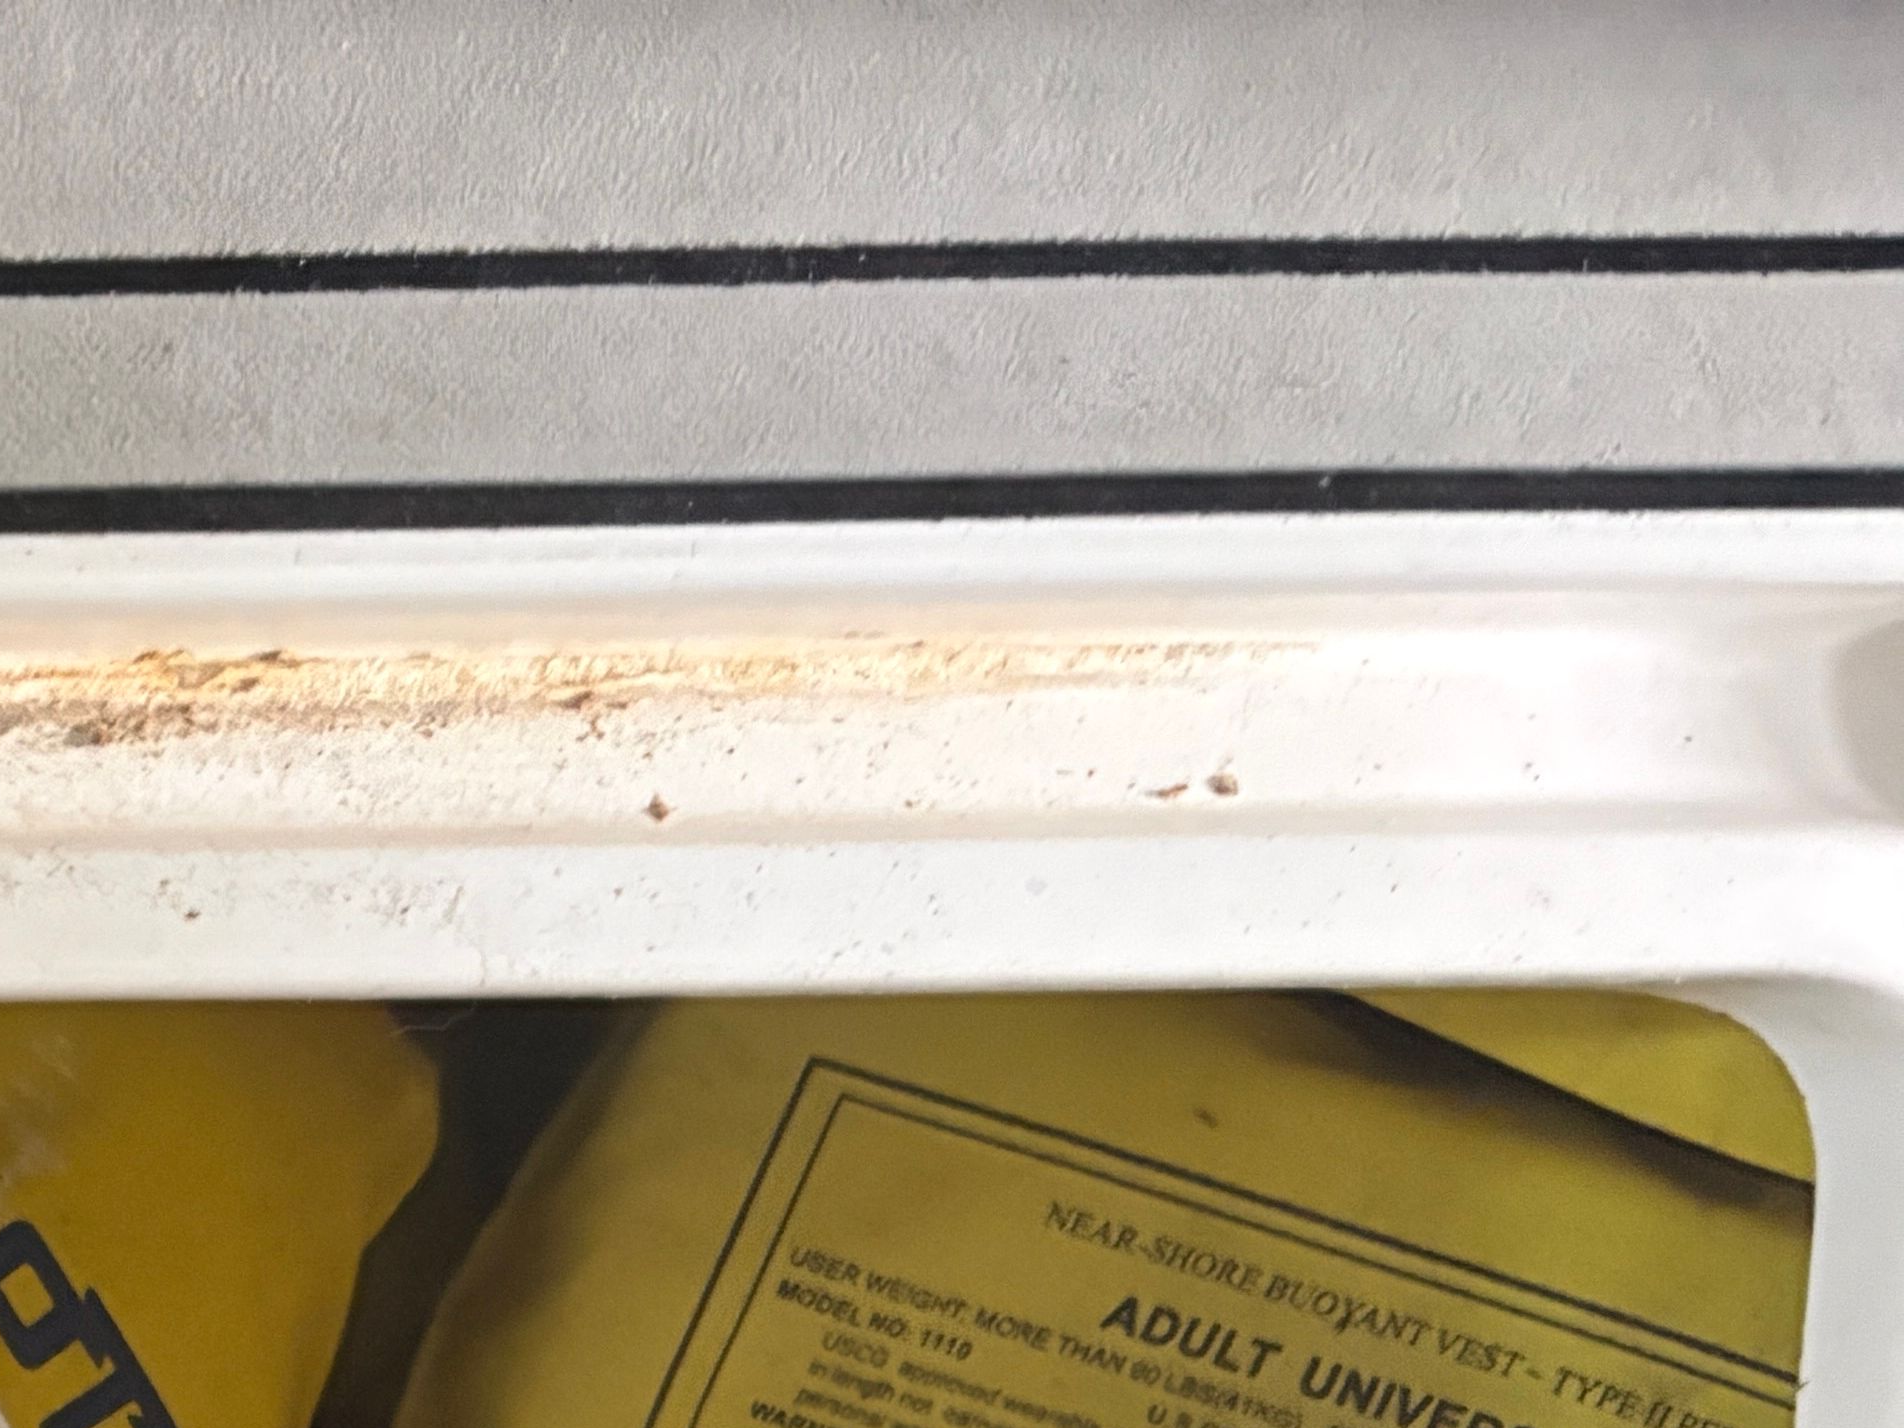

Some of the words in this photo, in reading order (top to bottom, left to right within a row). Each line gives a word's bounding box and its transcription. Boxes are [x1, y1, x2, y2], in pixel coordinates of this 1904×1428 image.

[776, 1280, 864, 1324] MODEL
[918, 1328, 973, 1361] 1110
[789, 1246, 861, 1285] USER
[972, 1308, 1051, 1349] MORE
[1057, 1337, 1125, 1374] THAN
[1045, 1203, 1259, 1292] NEAR-SHORE
[1265, 1276, 1429, 1348] BUOYANT
[1432, 1332, 1521, 1379] VEST
[1551, 1372, 1641, 1419] TYPE
[1105, 1294, 1280, 1378] ADULT
